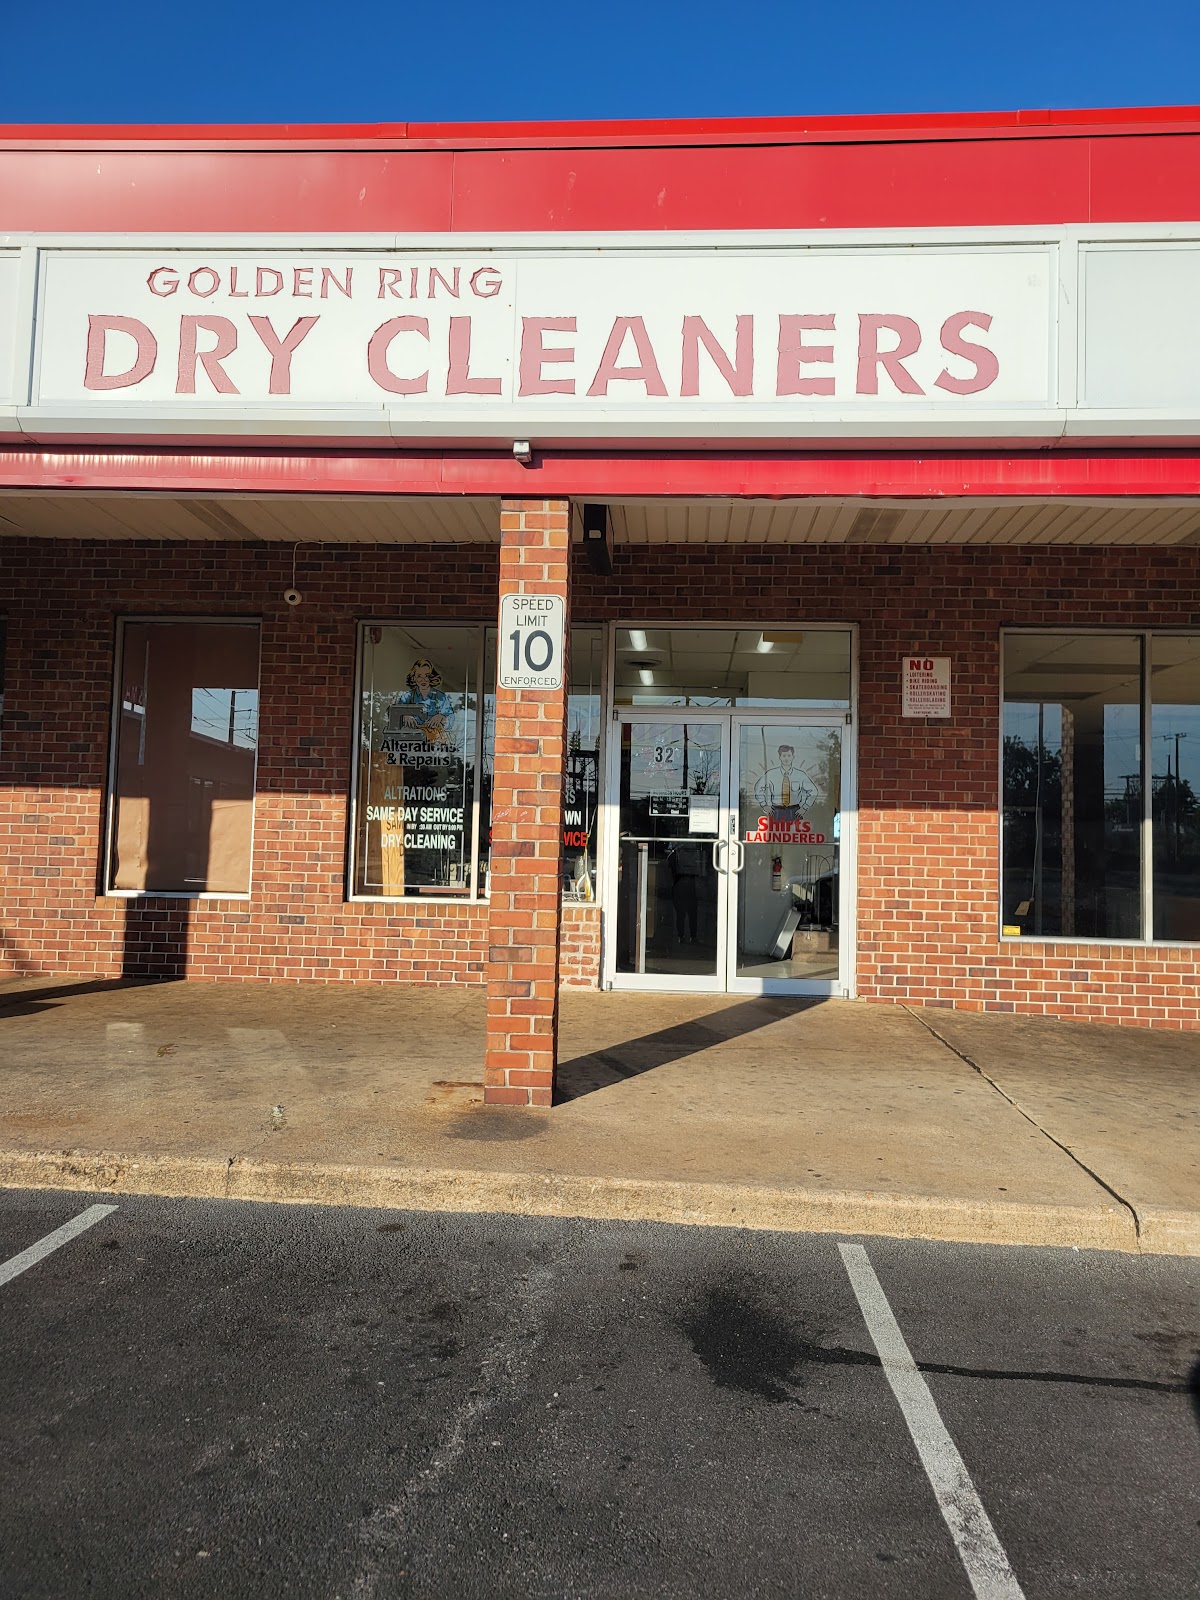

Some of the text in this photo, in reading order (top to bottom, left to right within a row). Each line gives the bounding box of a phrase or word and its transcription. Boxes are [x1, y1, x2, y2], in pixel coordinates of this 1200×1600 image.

[146, 266, 503, 299] GOLDEN RING
[84, 310, 999, 396] DRY CLEANERS
[512, 599, 554, 611] SPEED
[516, 615, 548, 627] LIMIT
[509, 629, 554, 672] 10
[909, 660, 934, 671] NO
[504, 676, 558, 686] ENFORCED
[386, 752, 450, 770] & Repairs
[655, 746, 674, 763] 32
[384, 785, 447, 802] ALTRATIONS
[366, 805, 464, 823] SAME DAY SERVICE
[758, 816, 811, 833] Shirts
[381, 833, 456, 849] DRY CLEANING
[746, 832, 825, 844] LAUNDERED
